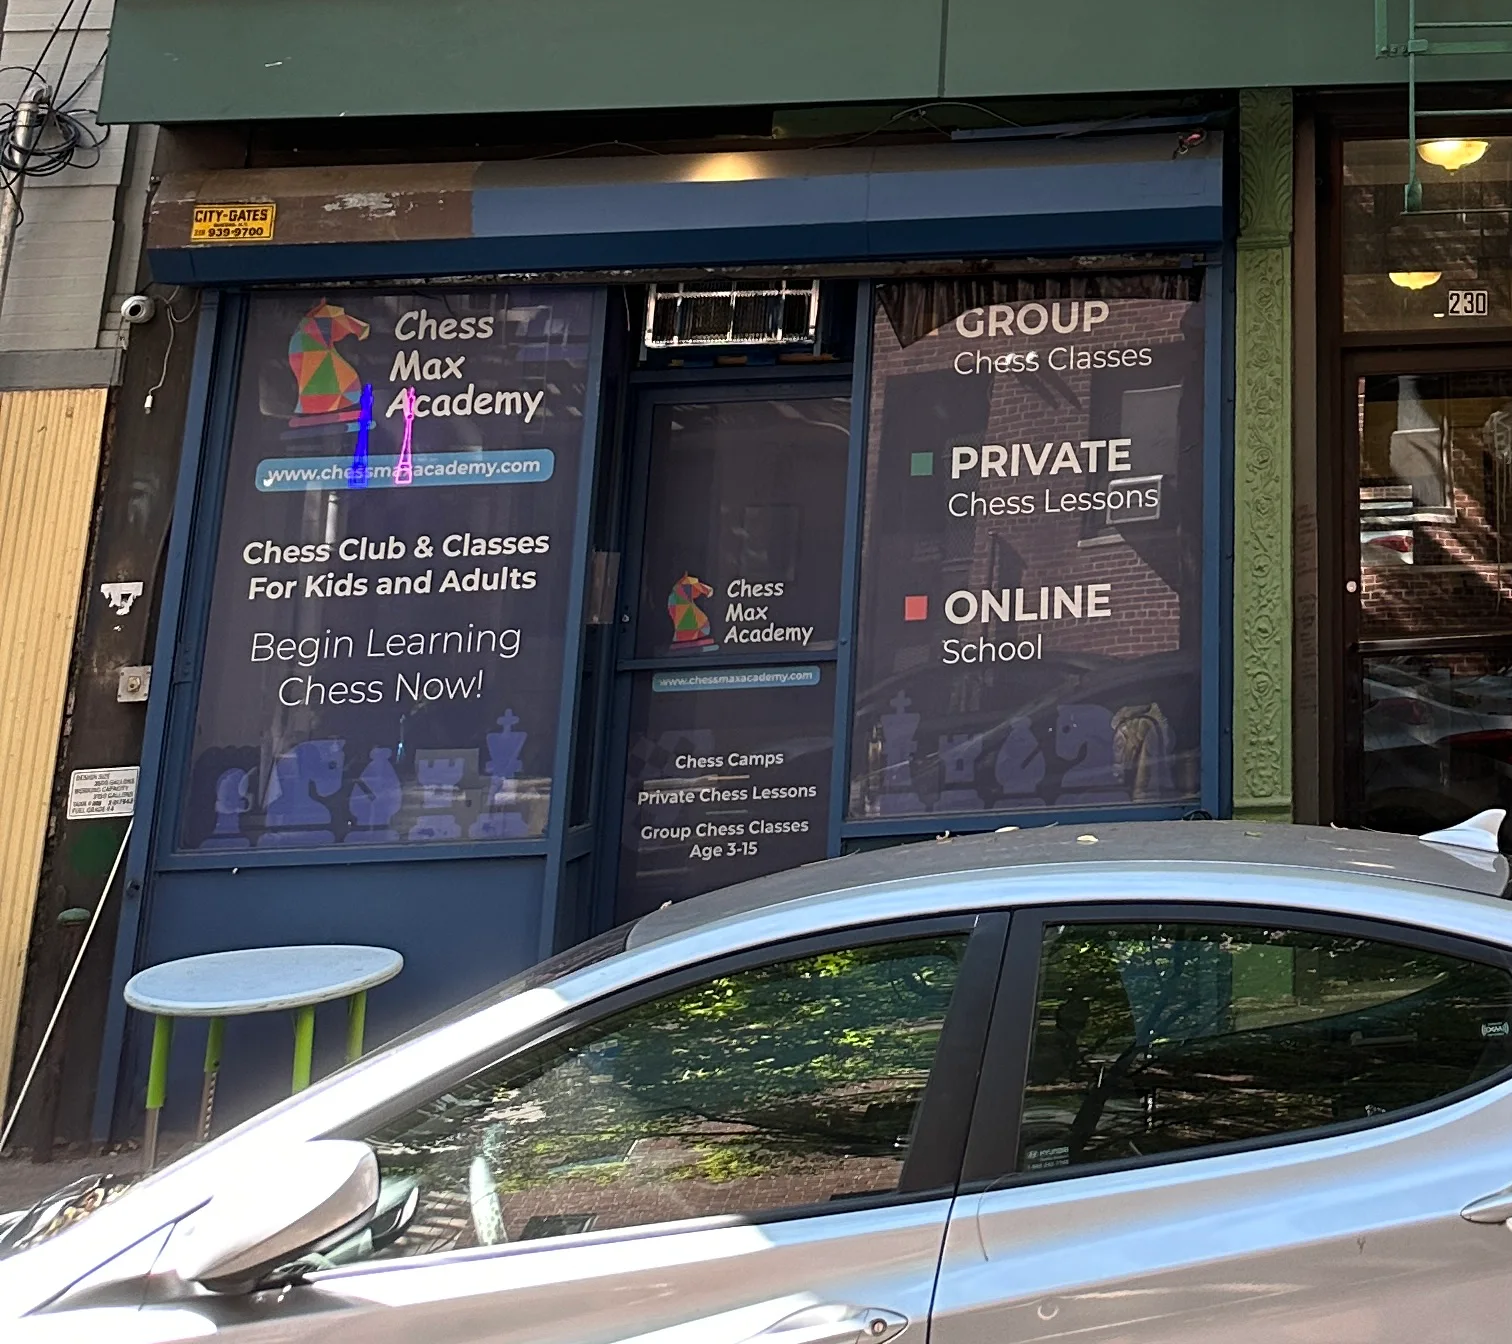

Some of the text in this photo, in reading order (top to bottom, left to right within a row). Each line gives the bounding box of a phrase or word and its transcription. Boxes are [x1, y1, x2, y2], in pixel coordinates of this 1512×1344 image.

[195, 209, 268, 223] CITY-GATES
[1449, 293, 1486, 314] 230
[395, 309, 494, 341] Chess
[955, 300, 1110, 338] GROUP
[389, 350, 466, 381] Max
[953, 345, 1153, 375] Chess Classes
[385, 383, 544, 424] Academy
[268, 458, 540, 482] www.chessmaxacademy.com
[951, 438, 1132, 479] PRIVATE
[948, 488, 1159, 518] Chess Lessons
[243, 532, 550, 564] Chess Club & Classes
[248, 566, 537, 600] For Kids and Adults
[727, 579, 784, 598] Chess
[725, 603, 769, 622] Max
[944, 583, 1112, 625] ONLINE
[250, 623, 521, 667] Begin Learning
[724, 622, 814, 646] Academy
[942, 633, 1043, 665] School
[278, 669, 484, 706] Chess Now!
[659, 670, 813, 686] www.chessmaxacademy.com
[675, 752, 784, 769] Chess Camps
[637, 784, 817, 805] Private Chess Lessons
[641, 819, 809, 841] Group Chess Classes
[689, 841, 758, 861] Age 3-15
